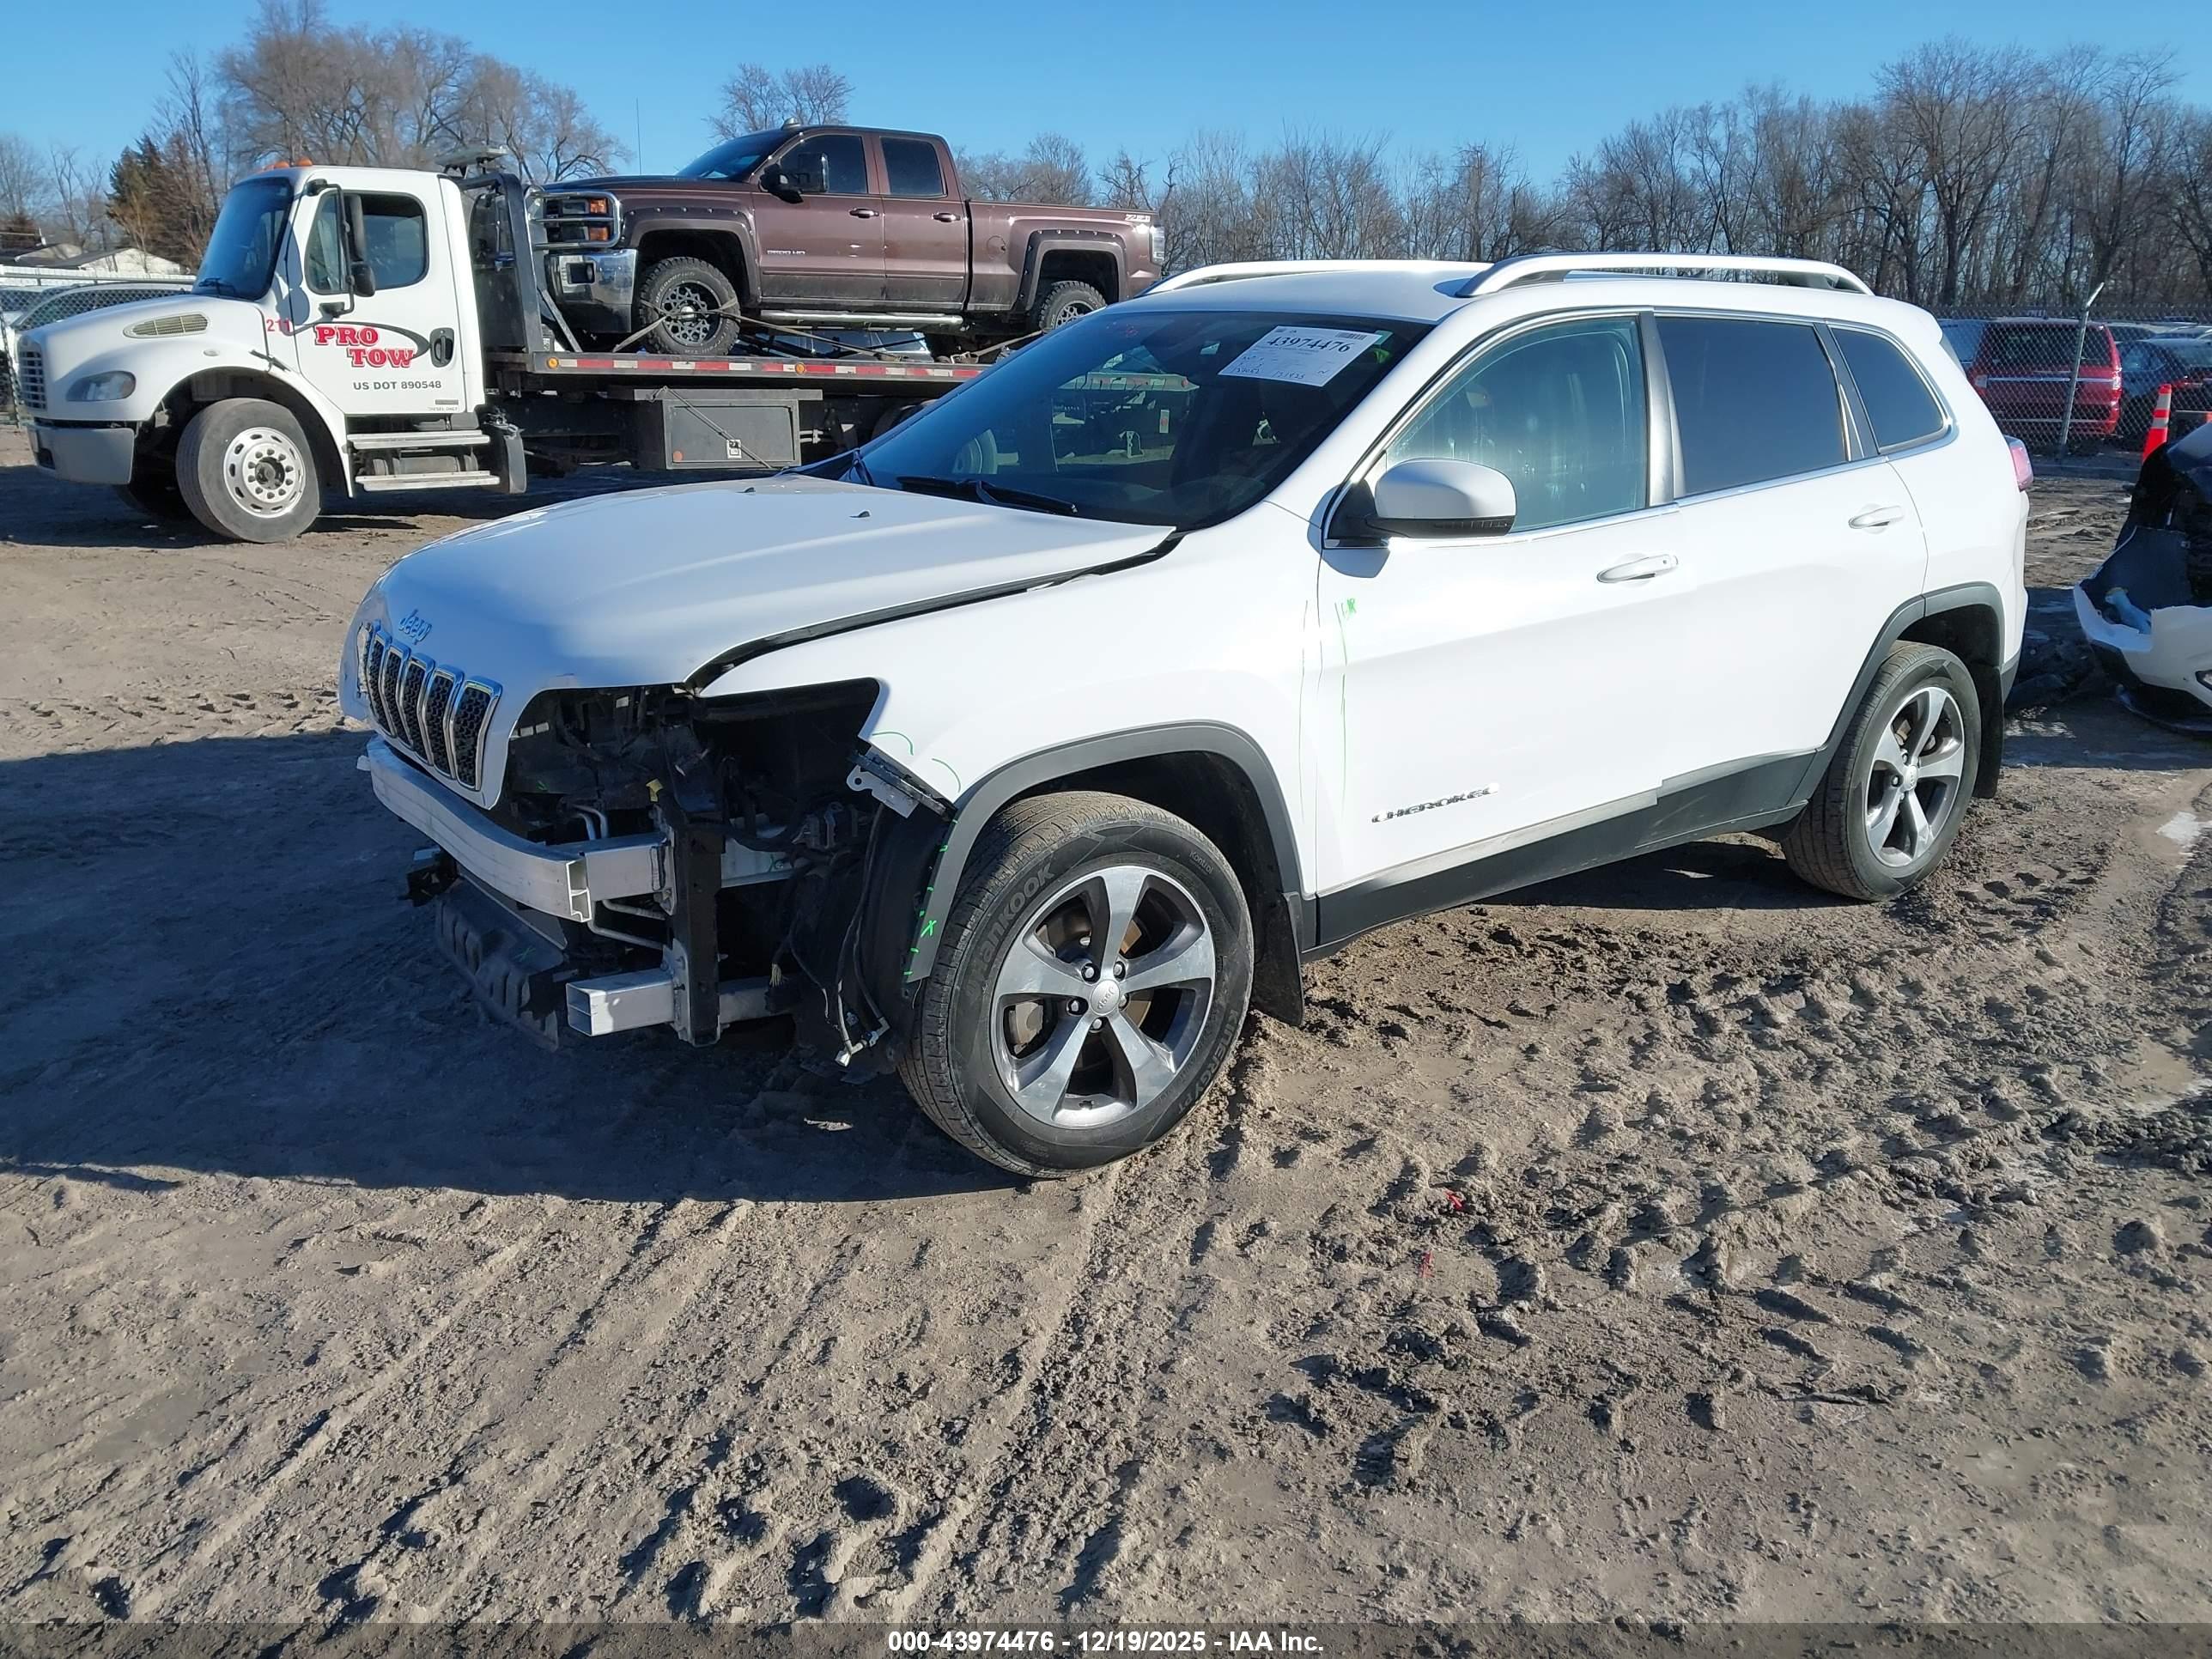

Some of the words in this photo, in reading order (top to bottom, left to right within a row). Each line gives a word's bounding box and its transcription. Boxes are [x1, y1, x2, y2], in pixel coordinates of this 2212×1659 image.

[266, 319, 290, 332] 211
[314, 325, 380, 346] PRO
[1267, 336, 1355, 354] 43974476
[348, 348, 415, 368] TOW
[353, 381, 370, 391] US
[373, 380, 398, 390] DOT
[400, 380, 442, 389] 890548
[398, 608, 433, 646] Jeep
